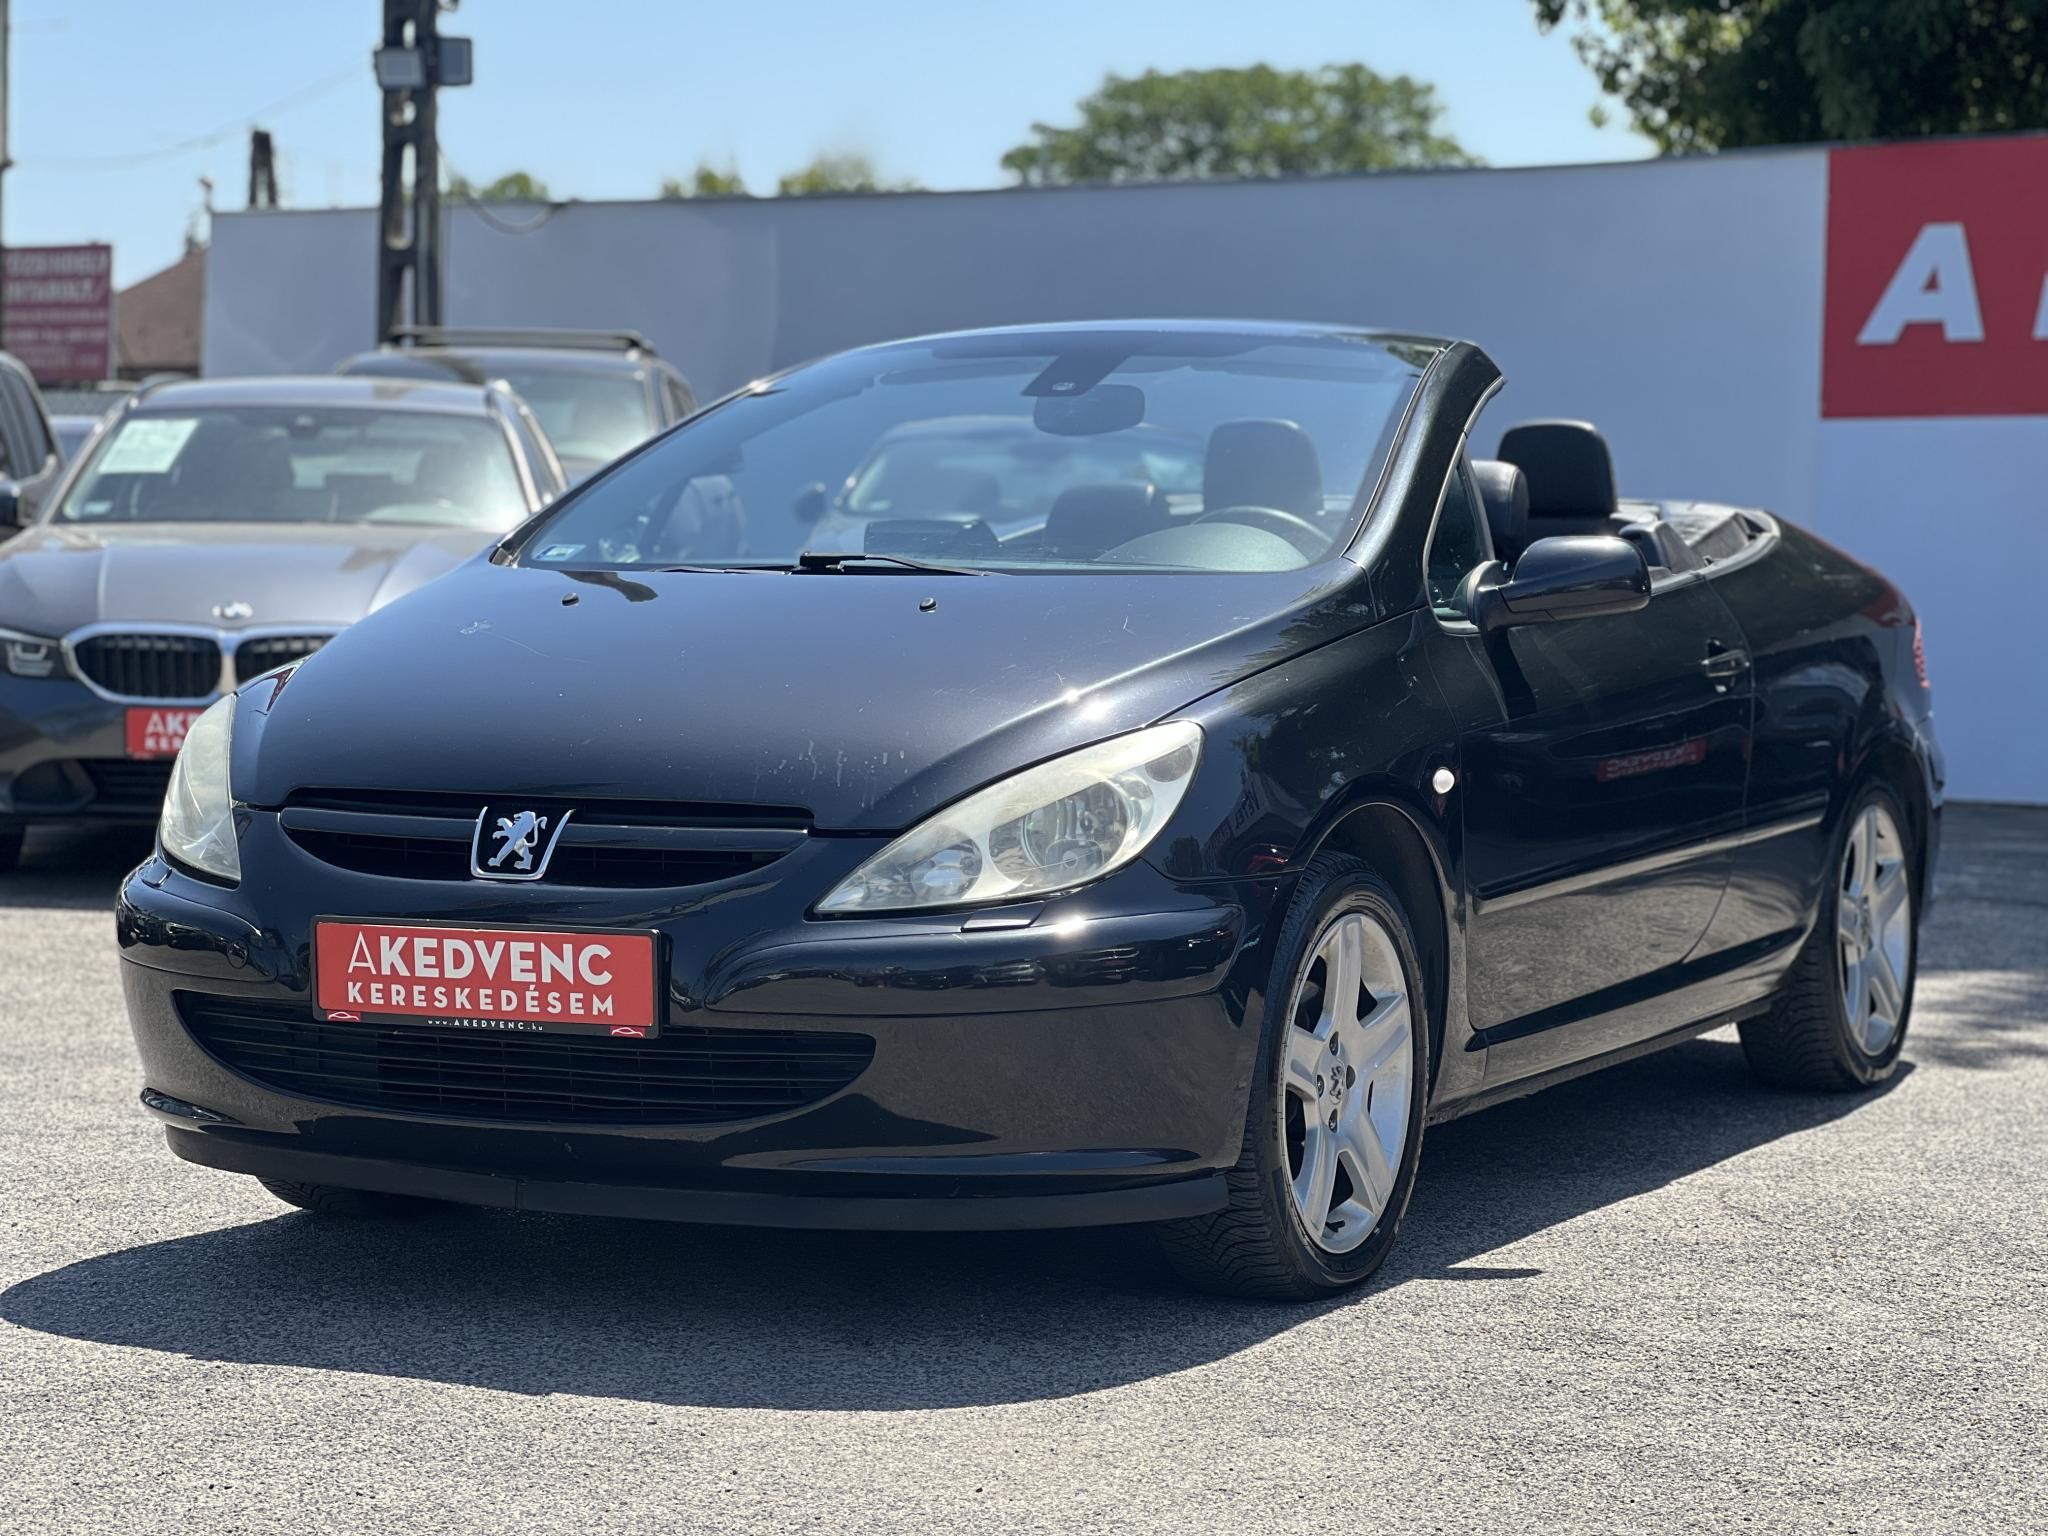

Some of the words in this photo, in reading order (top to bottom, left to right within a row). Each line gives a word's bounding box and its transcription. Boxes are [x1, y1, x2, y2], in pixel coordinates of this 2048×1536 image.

[347, 931, 613, 986] AKEDVENC
[347, 982, 614, 1016] KERESKEDÉSEM
[427, 1019, 543, 1031] www.AKEDVENC.hu
